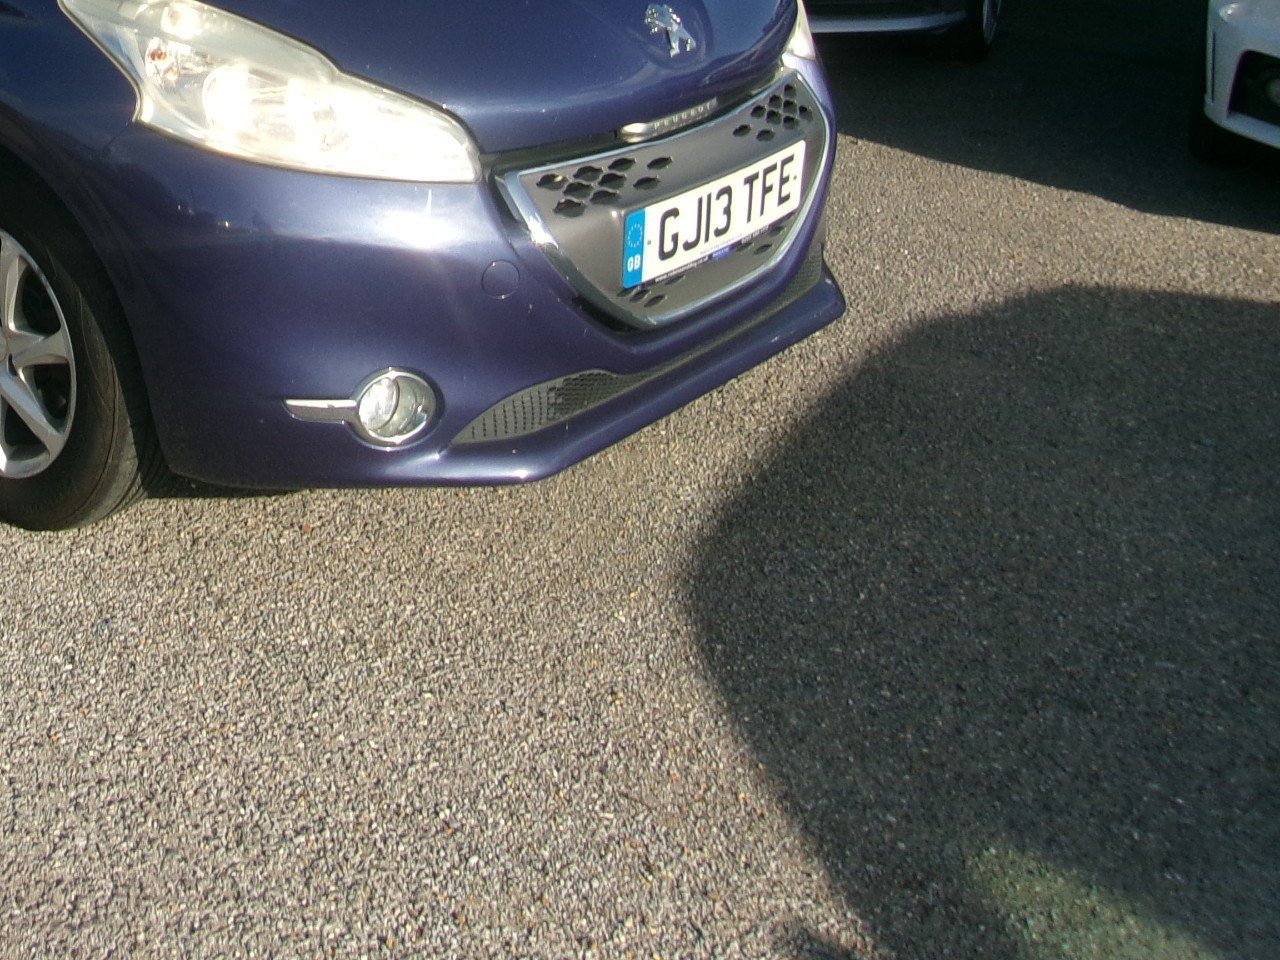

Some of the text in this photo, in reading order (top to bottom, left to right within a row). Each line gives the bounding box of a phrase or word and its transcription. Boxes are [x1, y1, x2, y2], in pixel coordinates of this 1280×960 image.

[658, 153, 795, 261] GJ13 TFE
[627, 254, 641, 272] GB
